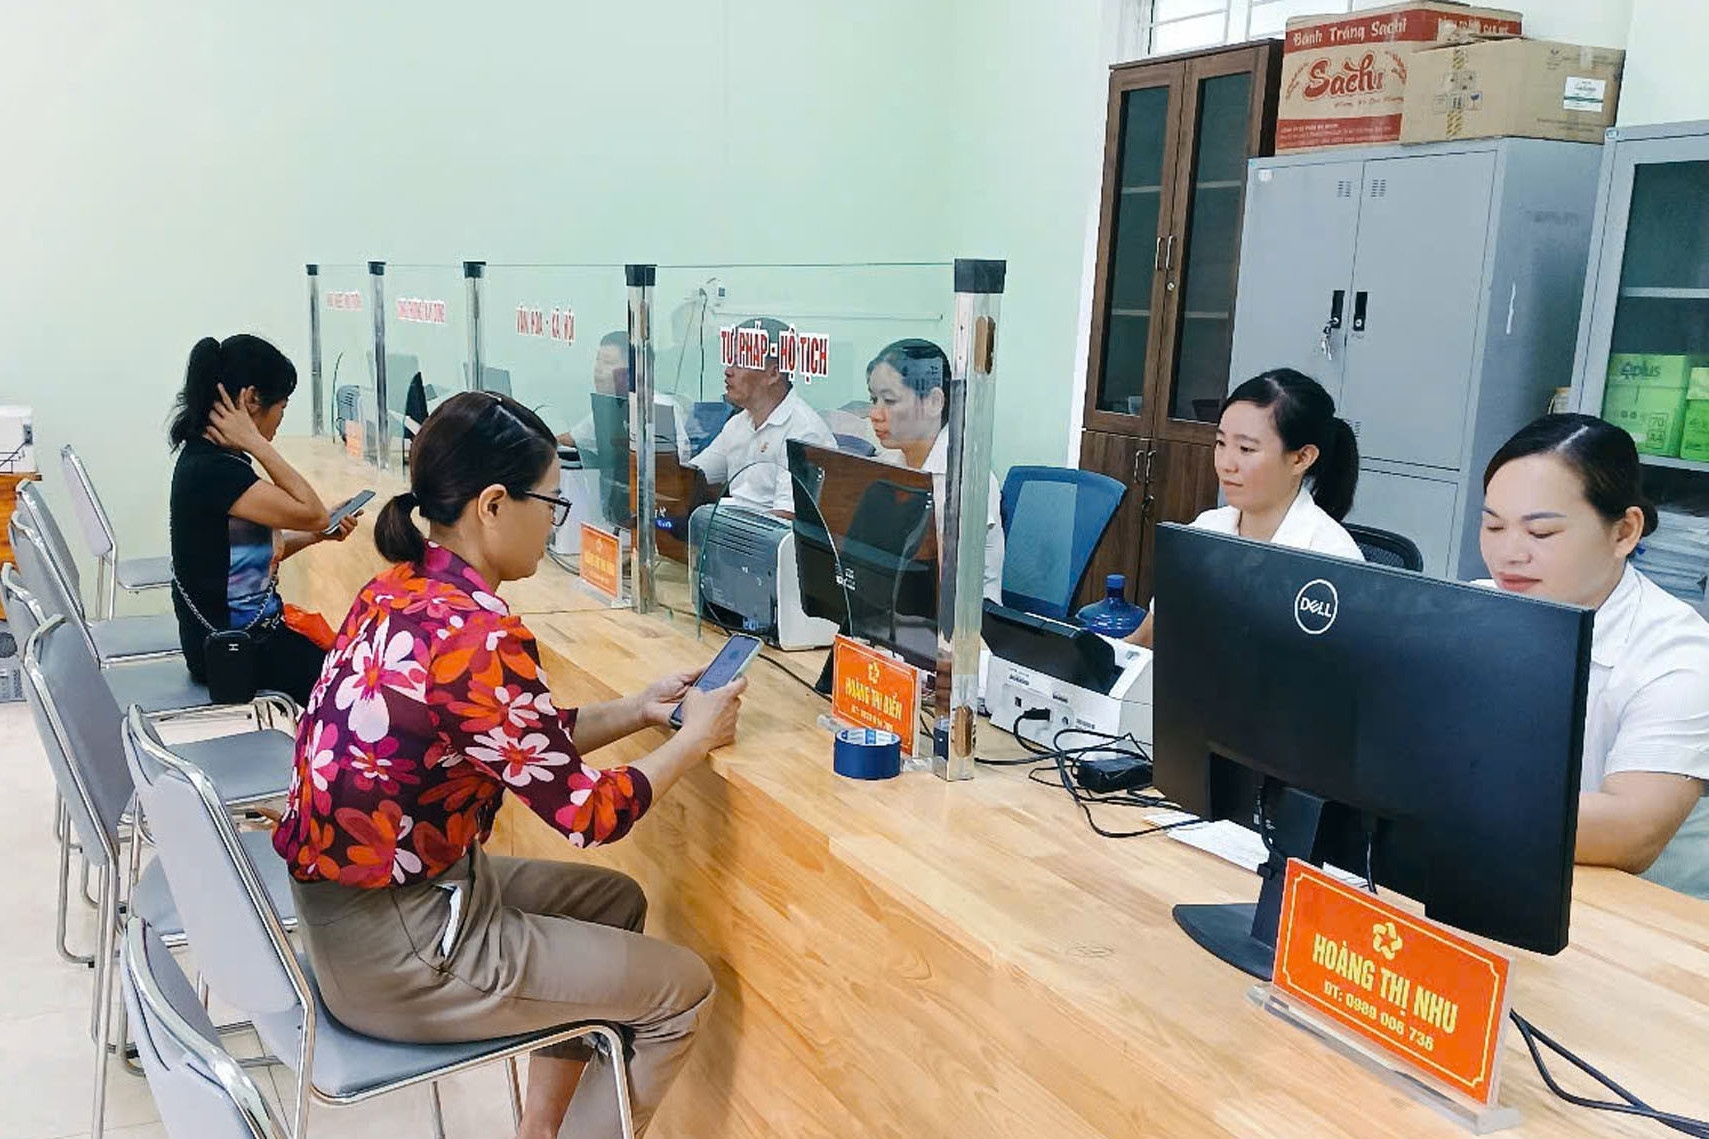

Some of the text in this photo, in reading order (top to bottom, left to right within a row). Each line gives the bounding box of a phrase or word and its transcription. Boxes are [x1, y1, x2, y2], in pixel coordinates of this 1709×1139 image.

[721, 326, 735, 365] TƯ
[739, 322, 768, 369] PHÁP
[780, 326, 797, 380] HỘ
[799, 336, 828, 382] TỊCH
[1300, 597, 1331, 617] DELL
[1312, 933, 1375, 991] HOÀNG
[1380, 966, 1411, 1016] THỊ
